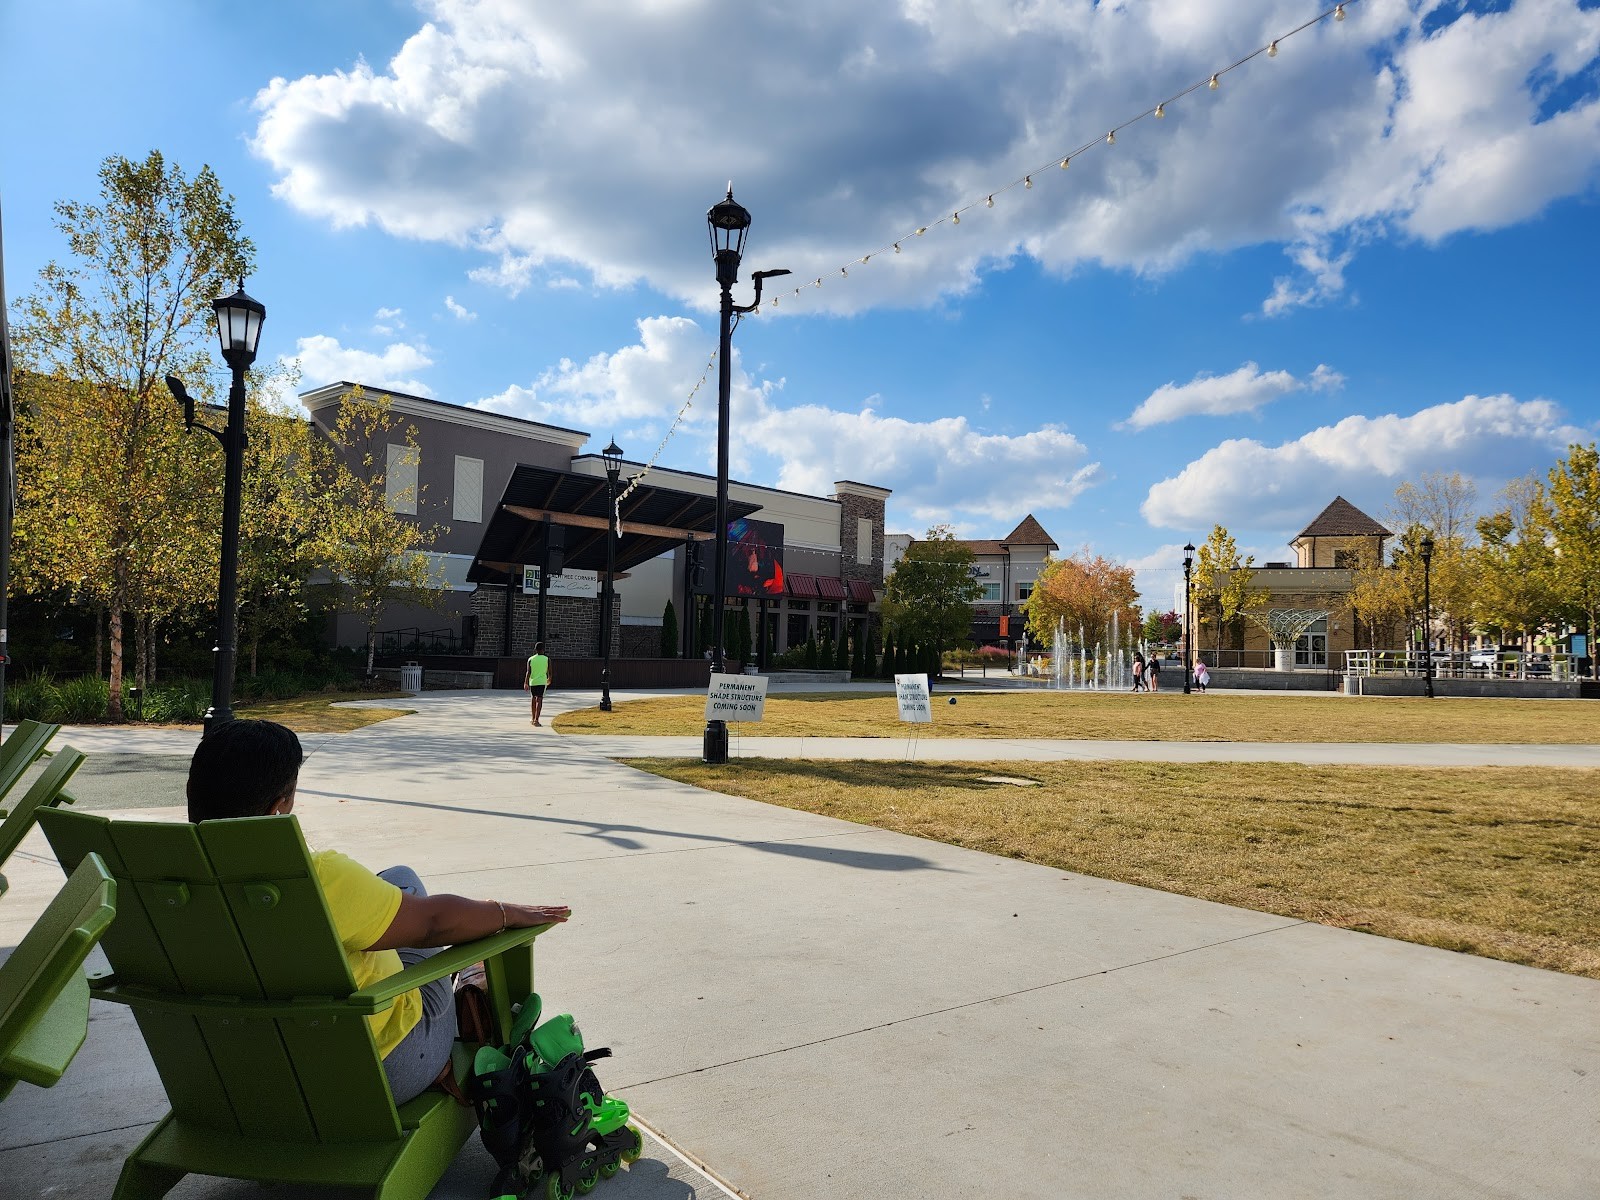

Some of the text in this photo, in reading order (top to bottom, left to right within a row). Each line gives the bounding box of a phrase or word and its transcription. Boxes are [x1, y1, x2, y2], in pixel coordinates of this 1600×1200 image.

[574, 574, 596, 582] CORNERS
[719, 682, 755, 691] PERMANENT
[710, 692, 763, 702] SHADE STRUCTURE
[713, 702, 738, 711] COMING
